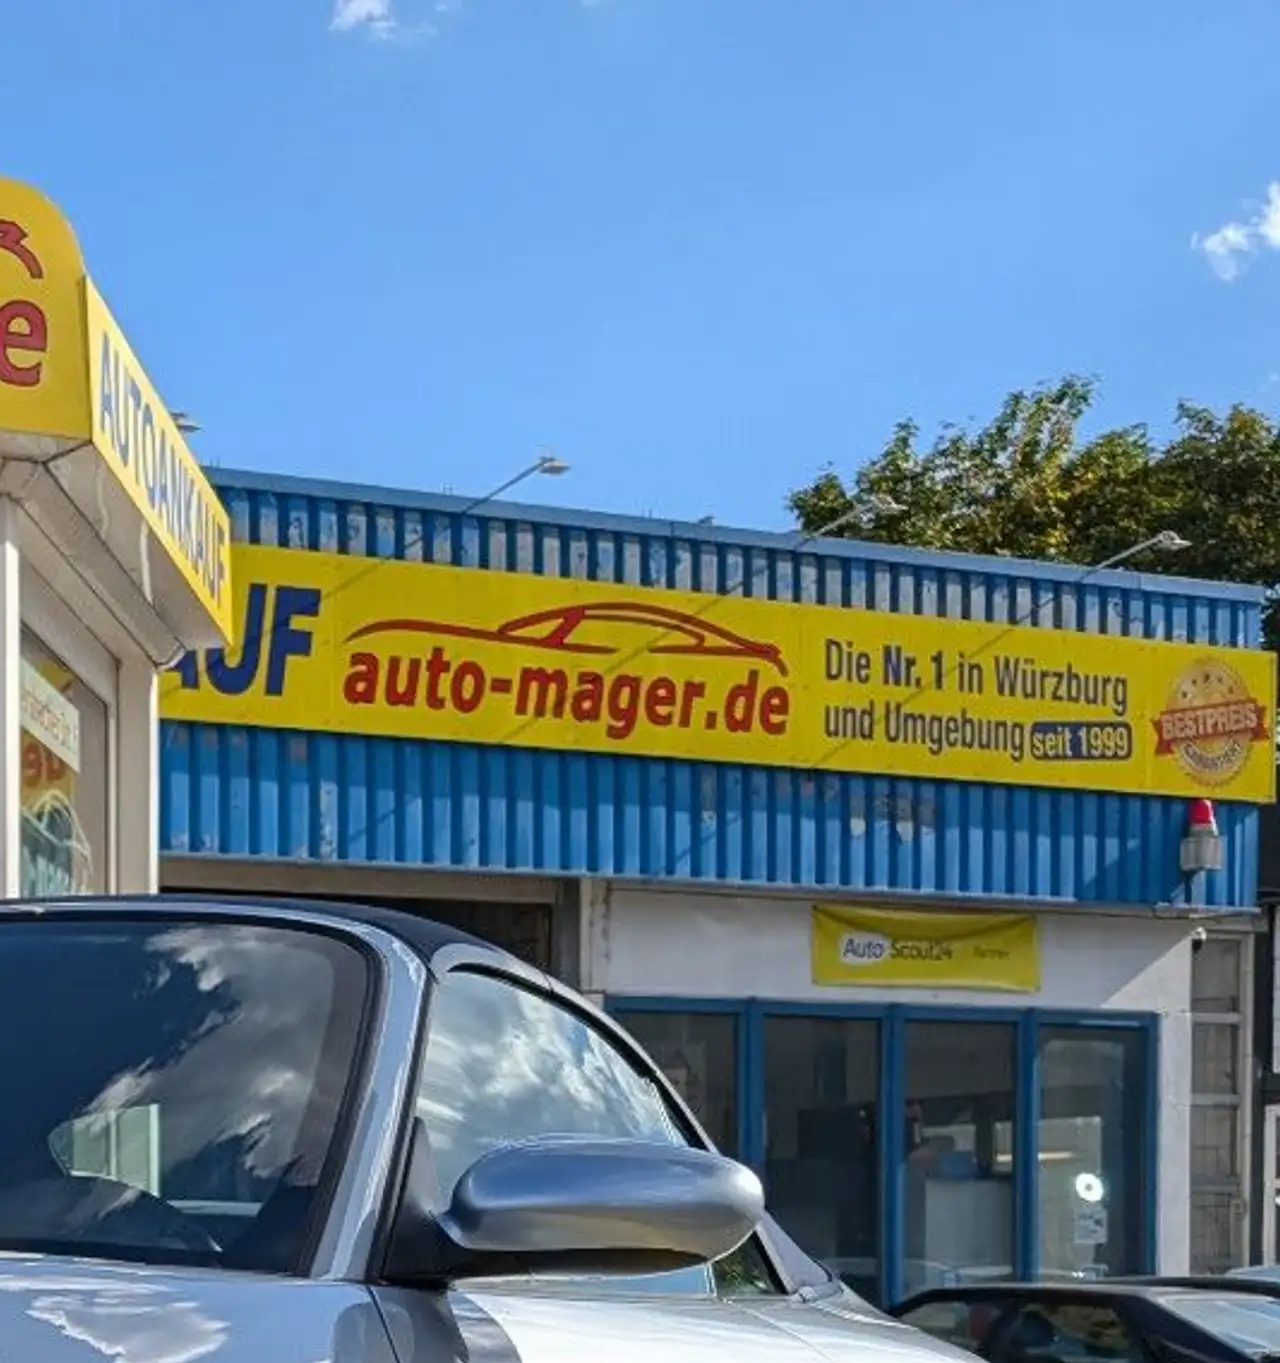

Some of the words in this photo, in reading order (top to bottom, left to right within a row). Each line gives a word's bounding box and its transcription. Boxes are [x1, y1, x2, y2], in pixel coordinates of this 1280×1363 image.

[99, 330, 225, 610] AUTOANKAUF
[342, 645, 790, 740] auto-mager.de
[824, 638, 871, 683] Die
[882, 644, 922, 689] Nr.
[930, 650, 944, 691] 1
[957, 652, 983, 695] in
[994, 654, 1128, 717] Würzburg
[824, 699, 875, 740] und
[883, 701, 1025, 762] Umgebung
[1032, 726, 1073, 757] seit
[1079, 728, 1129, 758] 1999
[1161, 701, 1259, 741] BESTPREIS
